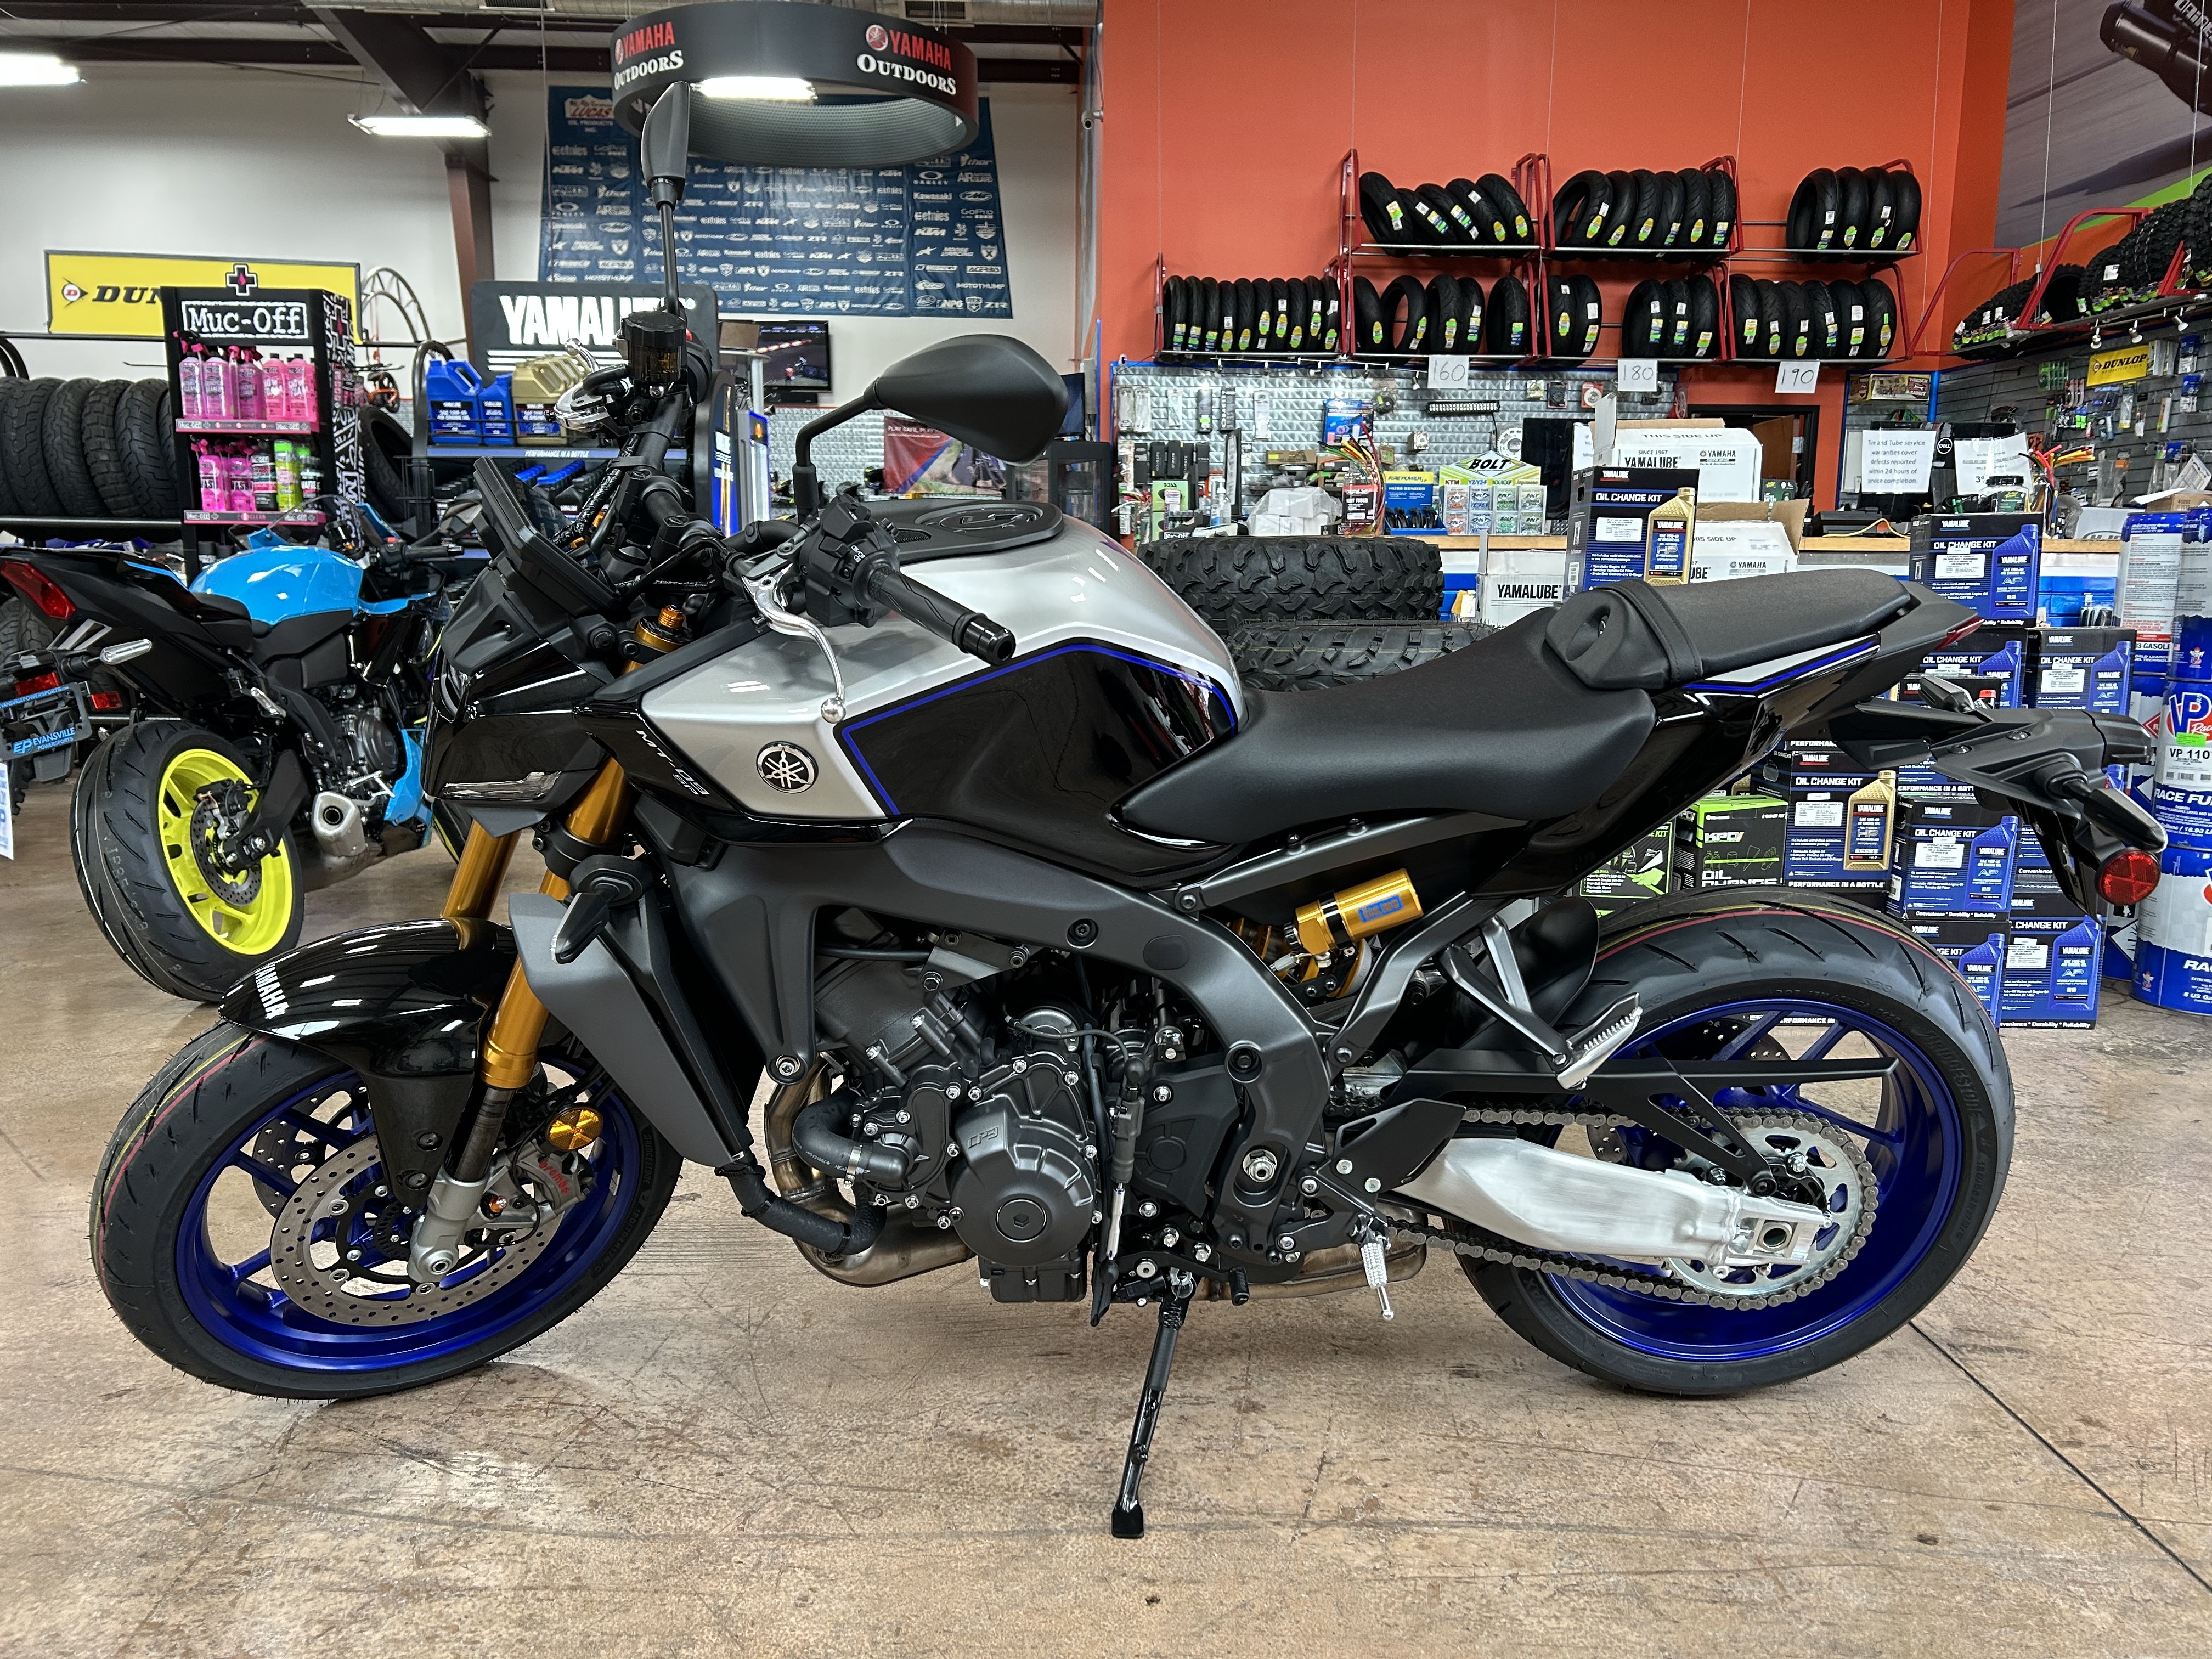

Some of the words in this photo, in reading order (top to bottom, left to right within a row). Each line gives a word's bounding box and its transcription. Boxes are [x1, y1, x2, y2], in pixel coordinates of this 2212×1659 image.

[622, 21, 675, 59] YAMAHA
[889, 30, 952, 71] YAMAHA
[856, 54, 957, 96] OUTDOORS
[914, 227, 946, 236] KTM
[189, 307, 303, 334] Muc-Off
[2102, 353, 2148, 370] DUNLOP
[1432, 360, 1465, 382] 160
[1622, 364, 1654, 383] 180
[1781, 369, 1814, 386] 190
[1469, 459, 1511, 469] BOLT
[1624, 456, 1678, 468] YAMALUBE
[1596, 493, 1610, 501] OIL
[1611, 493, 1647, 502] CHANGE
[1647, 494, 1663, 503] KIT
[1497, 584, 1559, 599] YAMALUBE
[33, 727, 76, 747] EVANSVILLE
[37, 736, 74, 751] POWERSPORTS
[13, 738, 33, 755] EP
[2170, 748, 2183, 758] VP
[2187, 749, 2210, 759] 110
[1811, 777, 1847, 786] CHANGE
[1848, 778, 1863, 786] KIT
[2154, 788, 2186, 803] RACE
[1925, 806, 1953, 815] YAMALUBE
[1702, 870, 1732, 881] OIL
[2016, 921, 2052, 929] CHANGE
[255, 961, 290, 1020] YAMAHA
[967, 1127, 998, 1149] CP3
[539, 1159, 570, 1194] brembo
